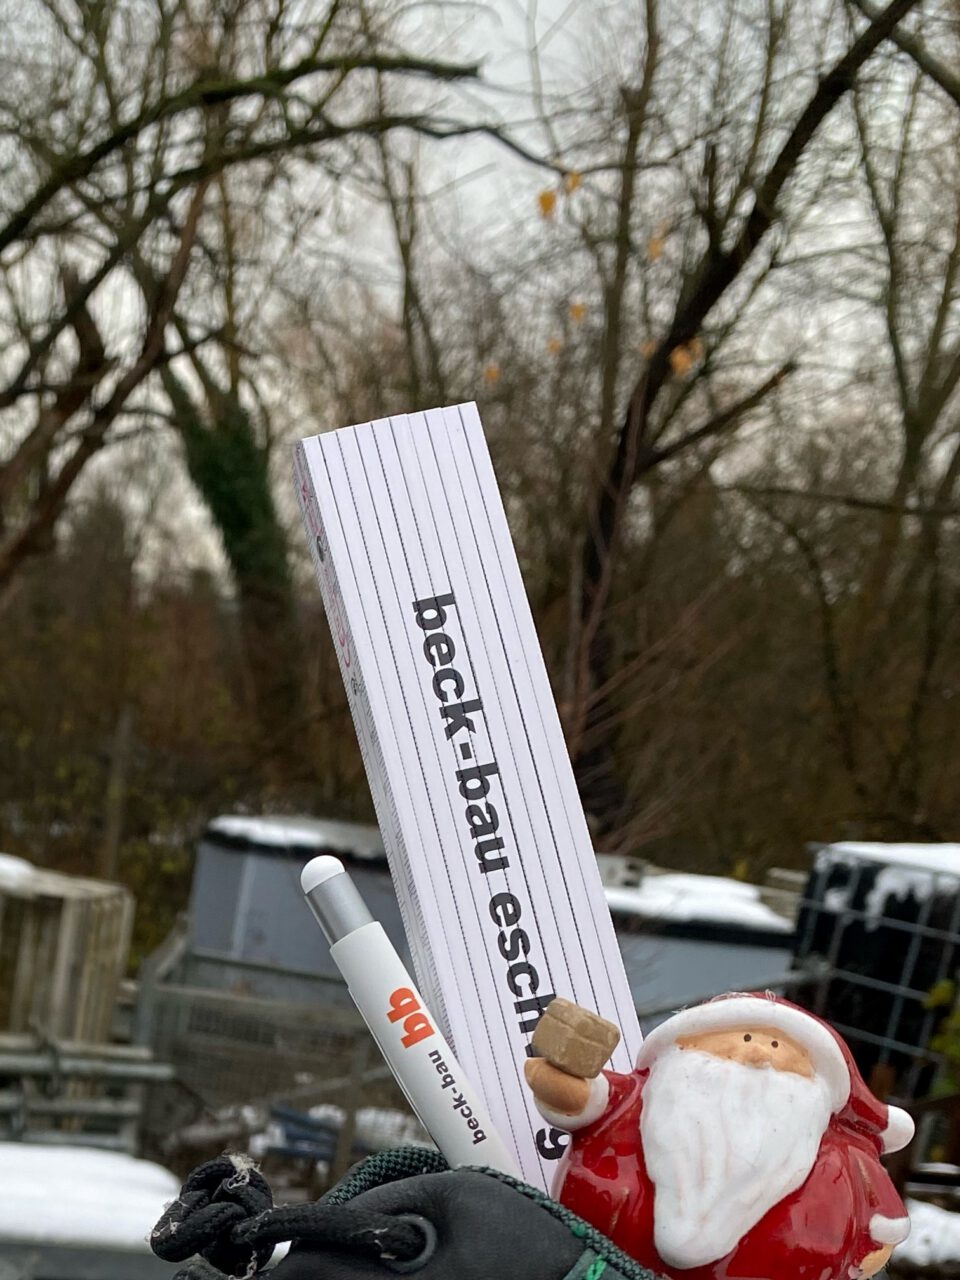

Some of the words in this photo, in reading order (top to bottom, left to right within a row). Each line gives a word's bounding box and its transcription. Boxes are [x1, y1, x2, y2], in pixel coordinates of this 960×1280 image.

[411, 591, 511, 875] beck-bau
[386, 987, 436, 1049] bb
[428, 1049, 488, 1146] beck-bau
